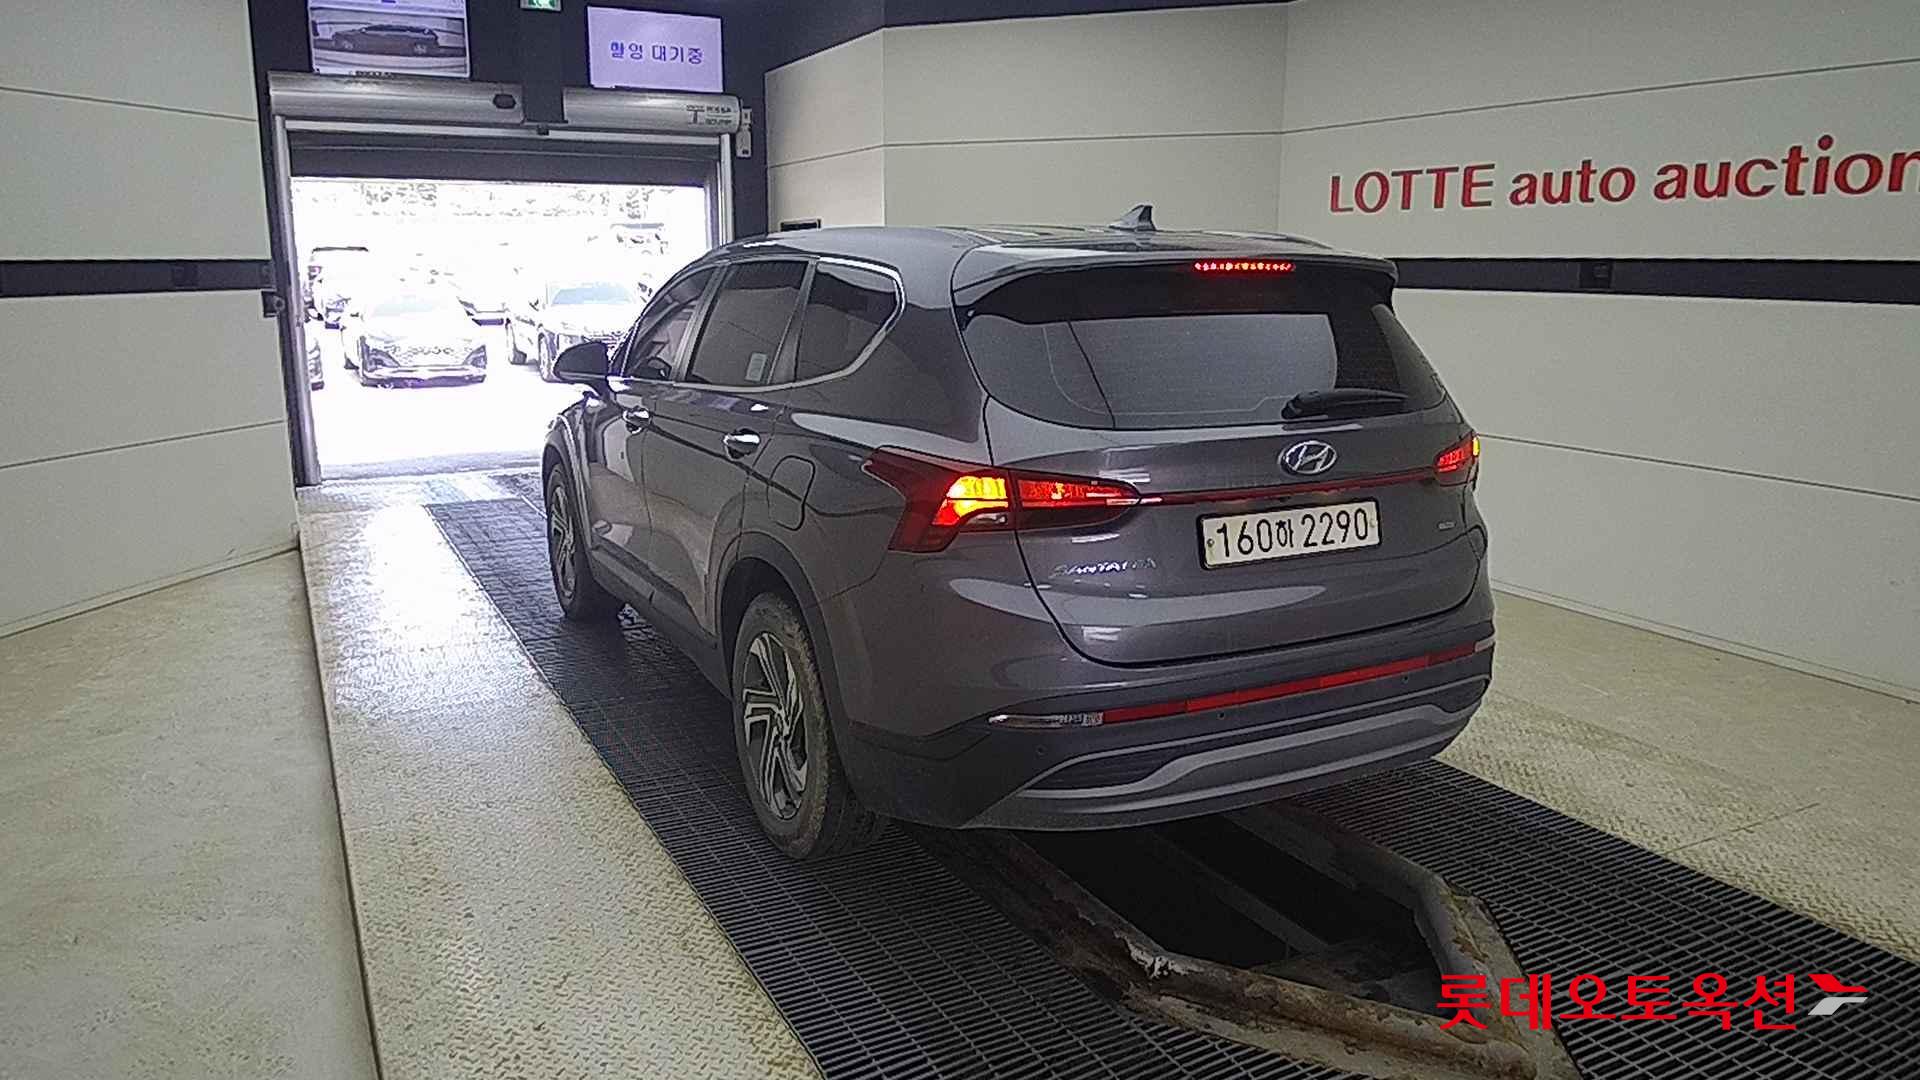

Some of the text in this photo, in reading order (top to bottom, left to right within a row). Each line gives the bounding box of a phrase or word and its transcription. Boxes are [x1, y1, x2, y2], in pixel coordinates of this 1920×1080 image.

[651, 45, 704, 65] 대기중
[1330, 134, 1920, 214] LOTTE auto auction
[1216, 508, 1368, 557] 160하 2290
